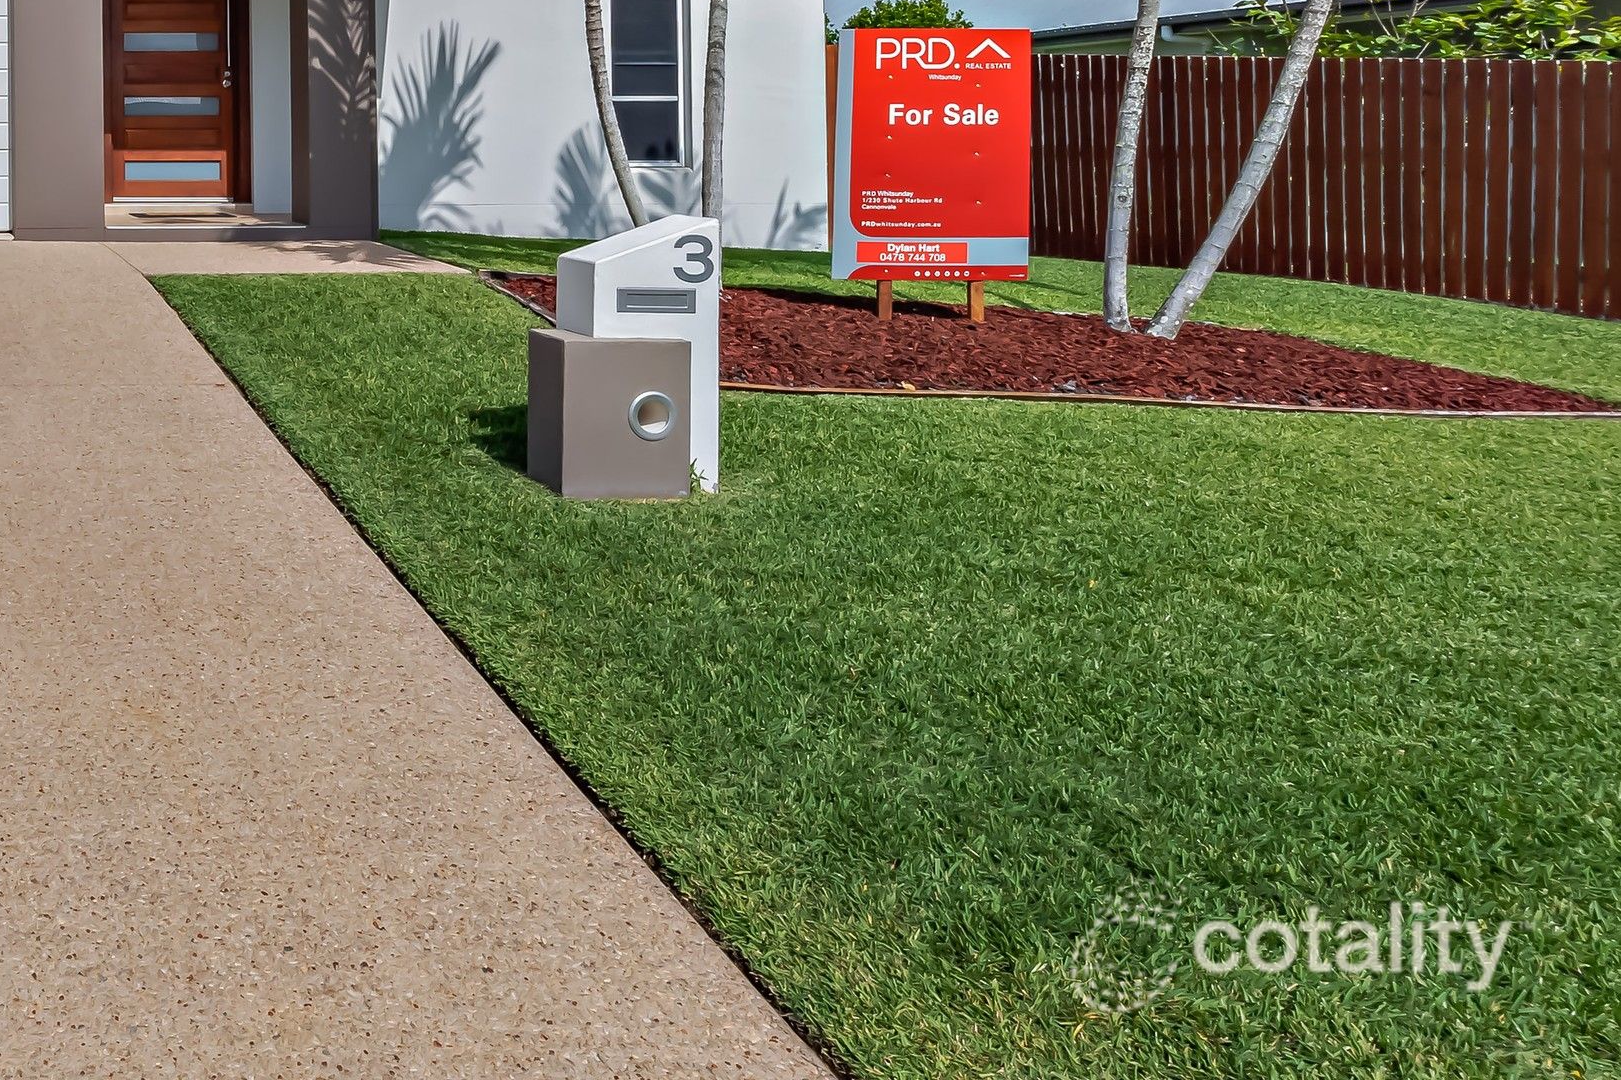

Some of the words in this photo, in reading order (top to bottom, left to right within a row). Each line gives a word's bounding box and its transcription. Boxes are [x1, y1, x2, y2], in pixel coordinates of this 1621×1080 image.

[888, 103, 933, 125] For
[943, 103, 999, 125] Sale
[887, 243, 916, 254] Dylan
[918, 243, 940, 252] Hart
[673, 234, 714, 283] 3
[879, 252, 905, 262] 0478
[908, 253, 925, 262] 744
[928, 253, 946, 262] 708
